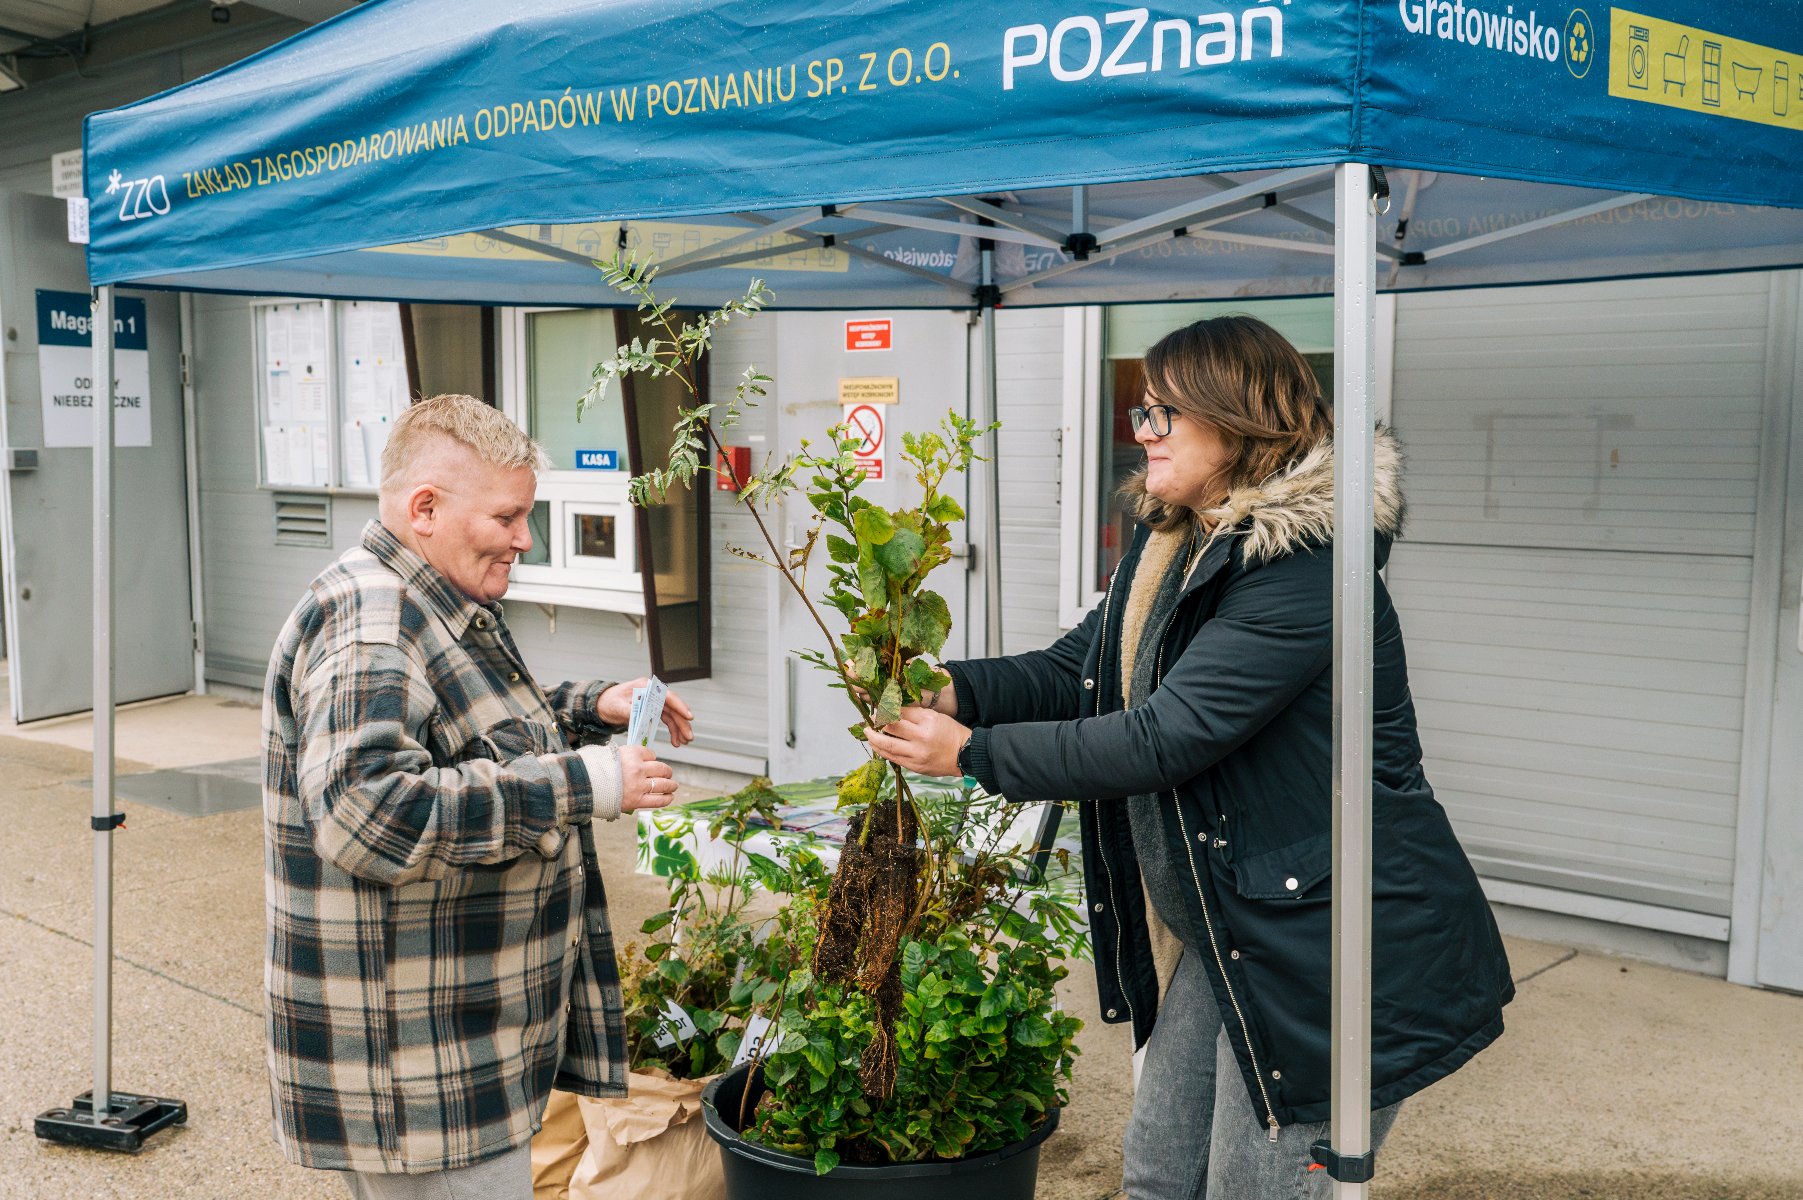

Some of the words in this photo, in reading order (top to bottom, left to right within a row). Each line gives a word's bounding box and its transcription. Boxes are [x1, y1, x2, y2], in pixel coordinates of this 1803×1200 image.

[1399, 0, 1560, 62] Gratowisko
[182, 162, 252, 198] ZAKŁAD
[251, 114, 469, 186] ZAGOSPODAROWANIA
[474, 87, 602, 141] ODPADÓW
[610, 86, 637, 122] W
[647, 64, 796, 119] POZNANIU
[806, 57, 847, 98] SP.
[857, 52, 877, 91] Z
[886, 41, 960, 87] O.O.
[50, 309, 124, 335] Magan
[127, 316, 136, 334] 1
[582, 453, 611, 466] KASA
